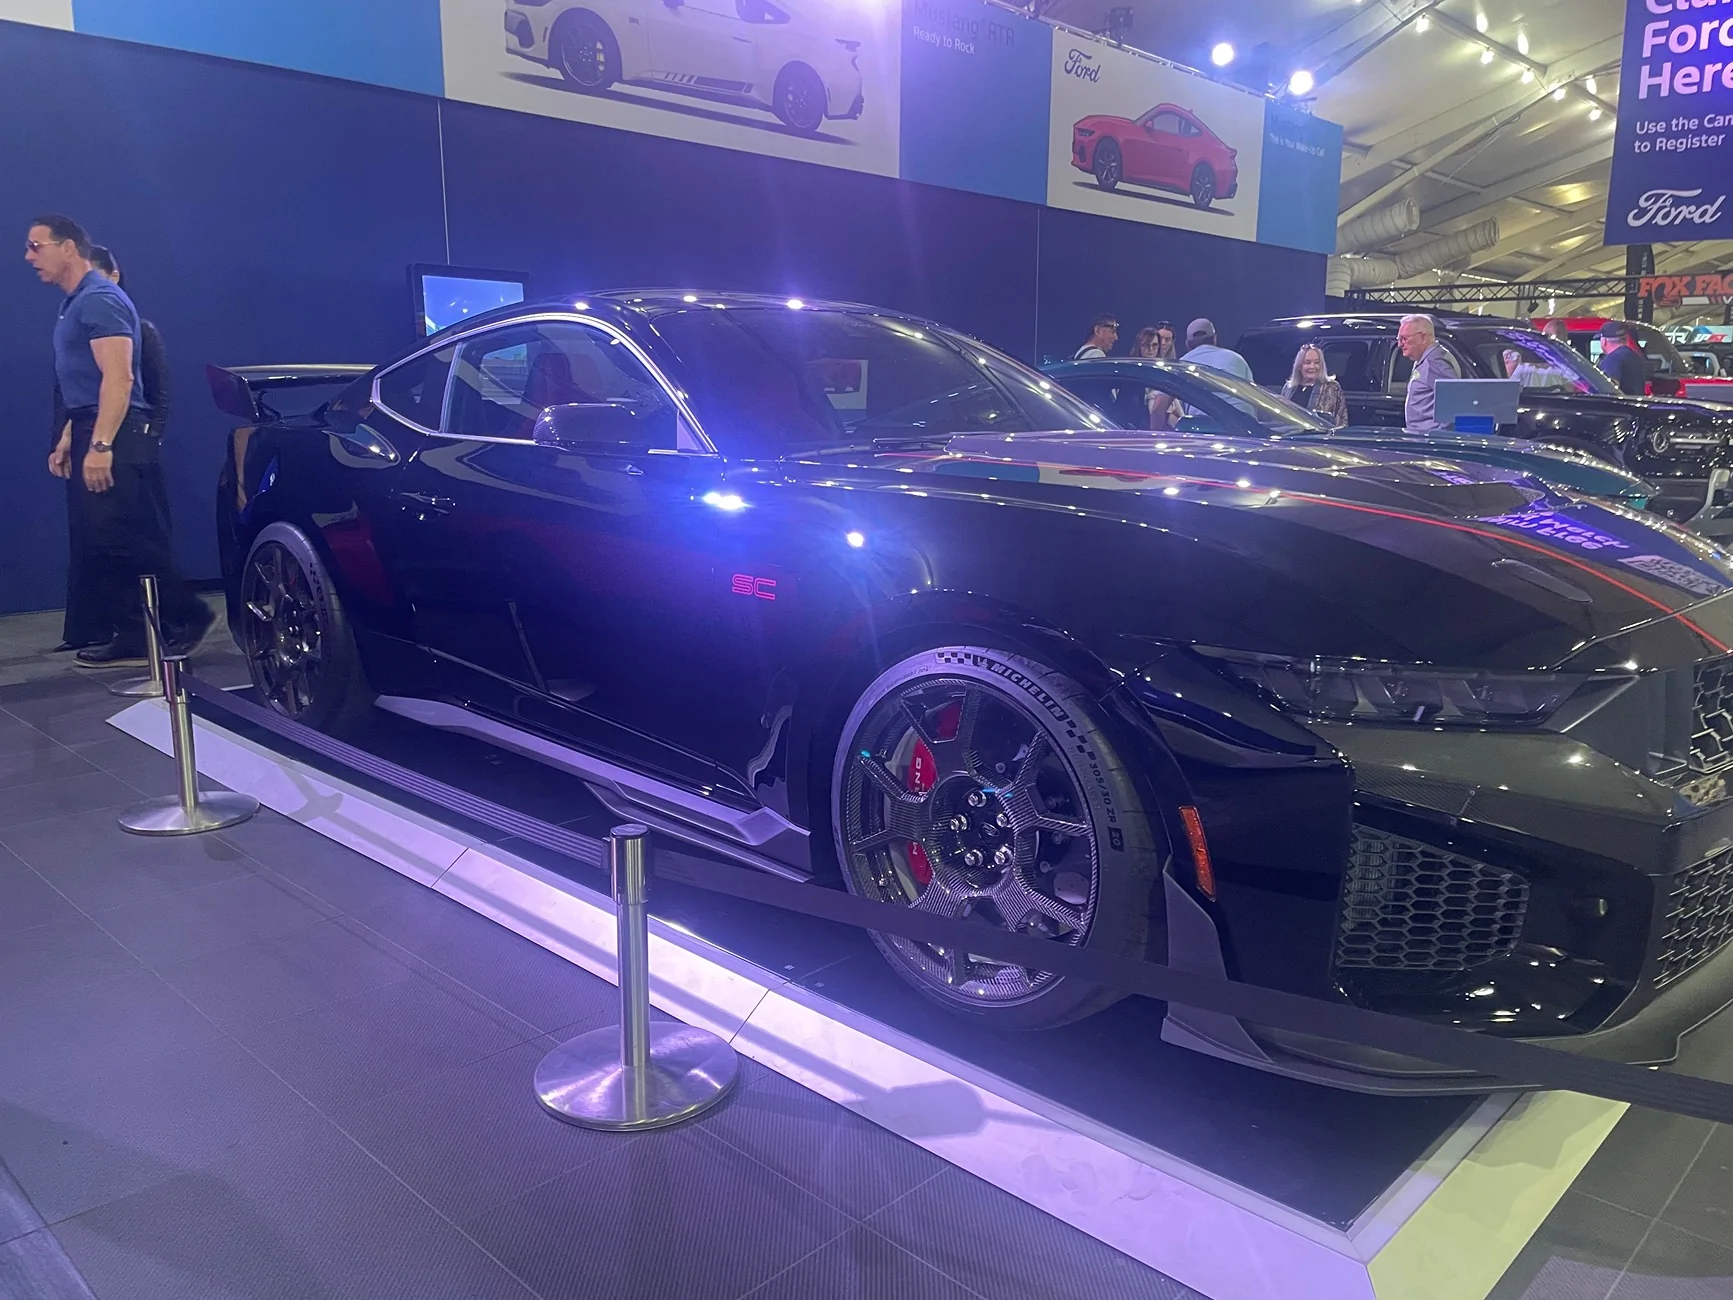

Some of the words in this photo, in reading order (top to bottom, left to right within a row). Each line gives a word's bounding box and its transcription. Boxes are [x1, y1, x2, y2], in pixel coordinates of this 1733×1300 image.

[913, 26, 941, 47] Ready
[943, 36, 952, 48] to
[954, 38, 975, 55] Rock
[1064, 48, 1101, 83] Ford
[1636, 120, 1666, 135] Use
[1671, 116, 1699, 132] the
[1634, 140, 1651, 153] to
[1655, 133, 1726, 152] Register
[1627, 188, 1726, 228] Ford
[1638, 275, 1692, 303] FOX
[732, 574, 777, 600] SC
[990, 662, 1066, 718] MICHELIN
[1089, 762, 1112, 806] 305/30
[1106, 807, 1117, 823] ZR
